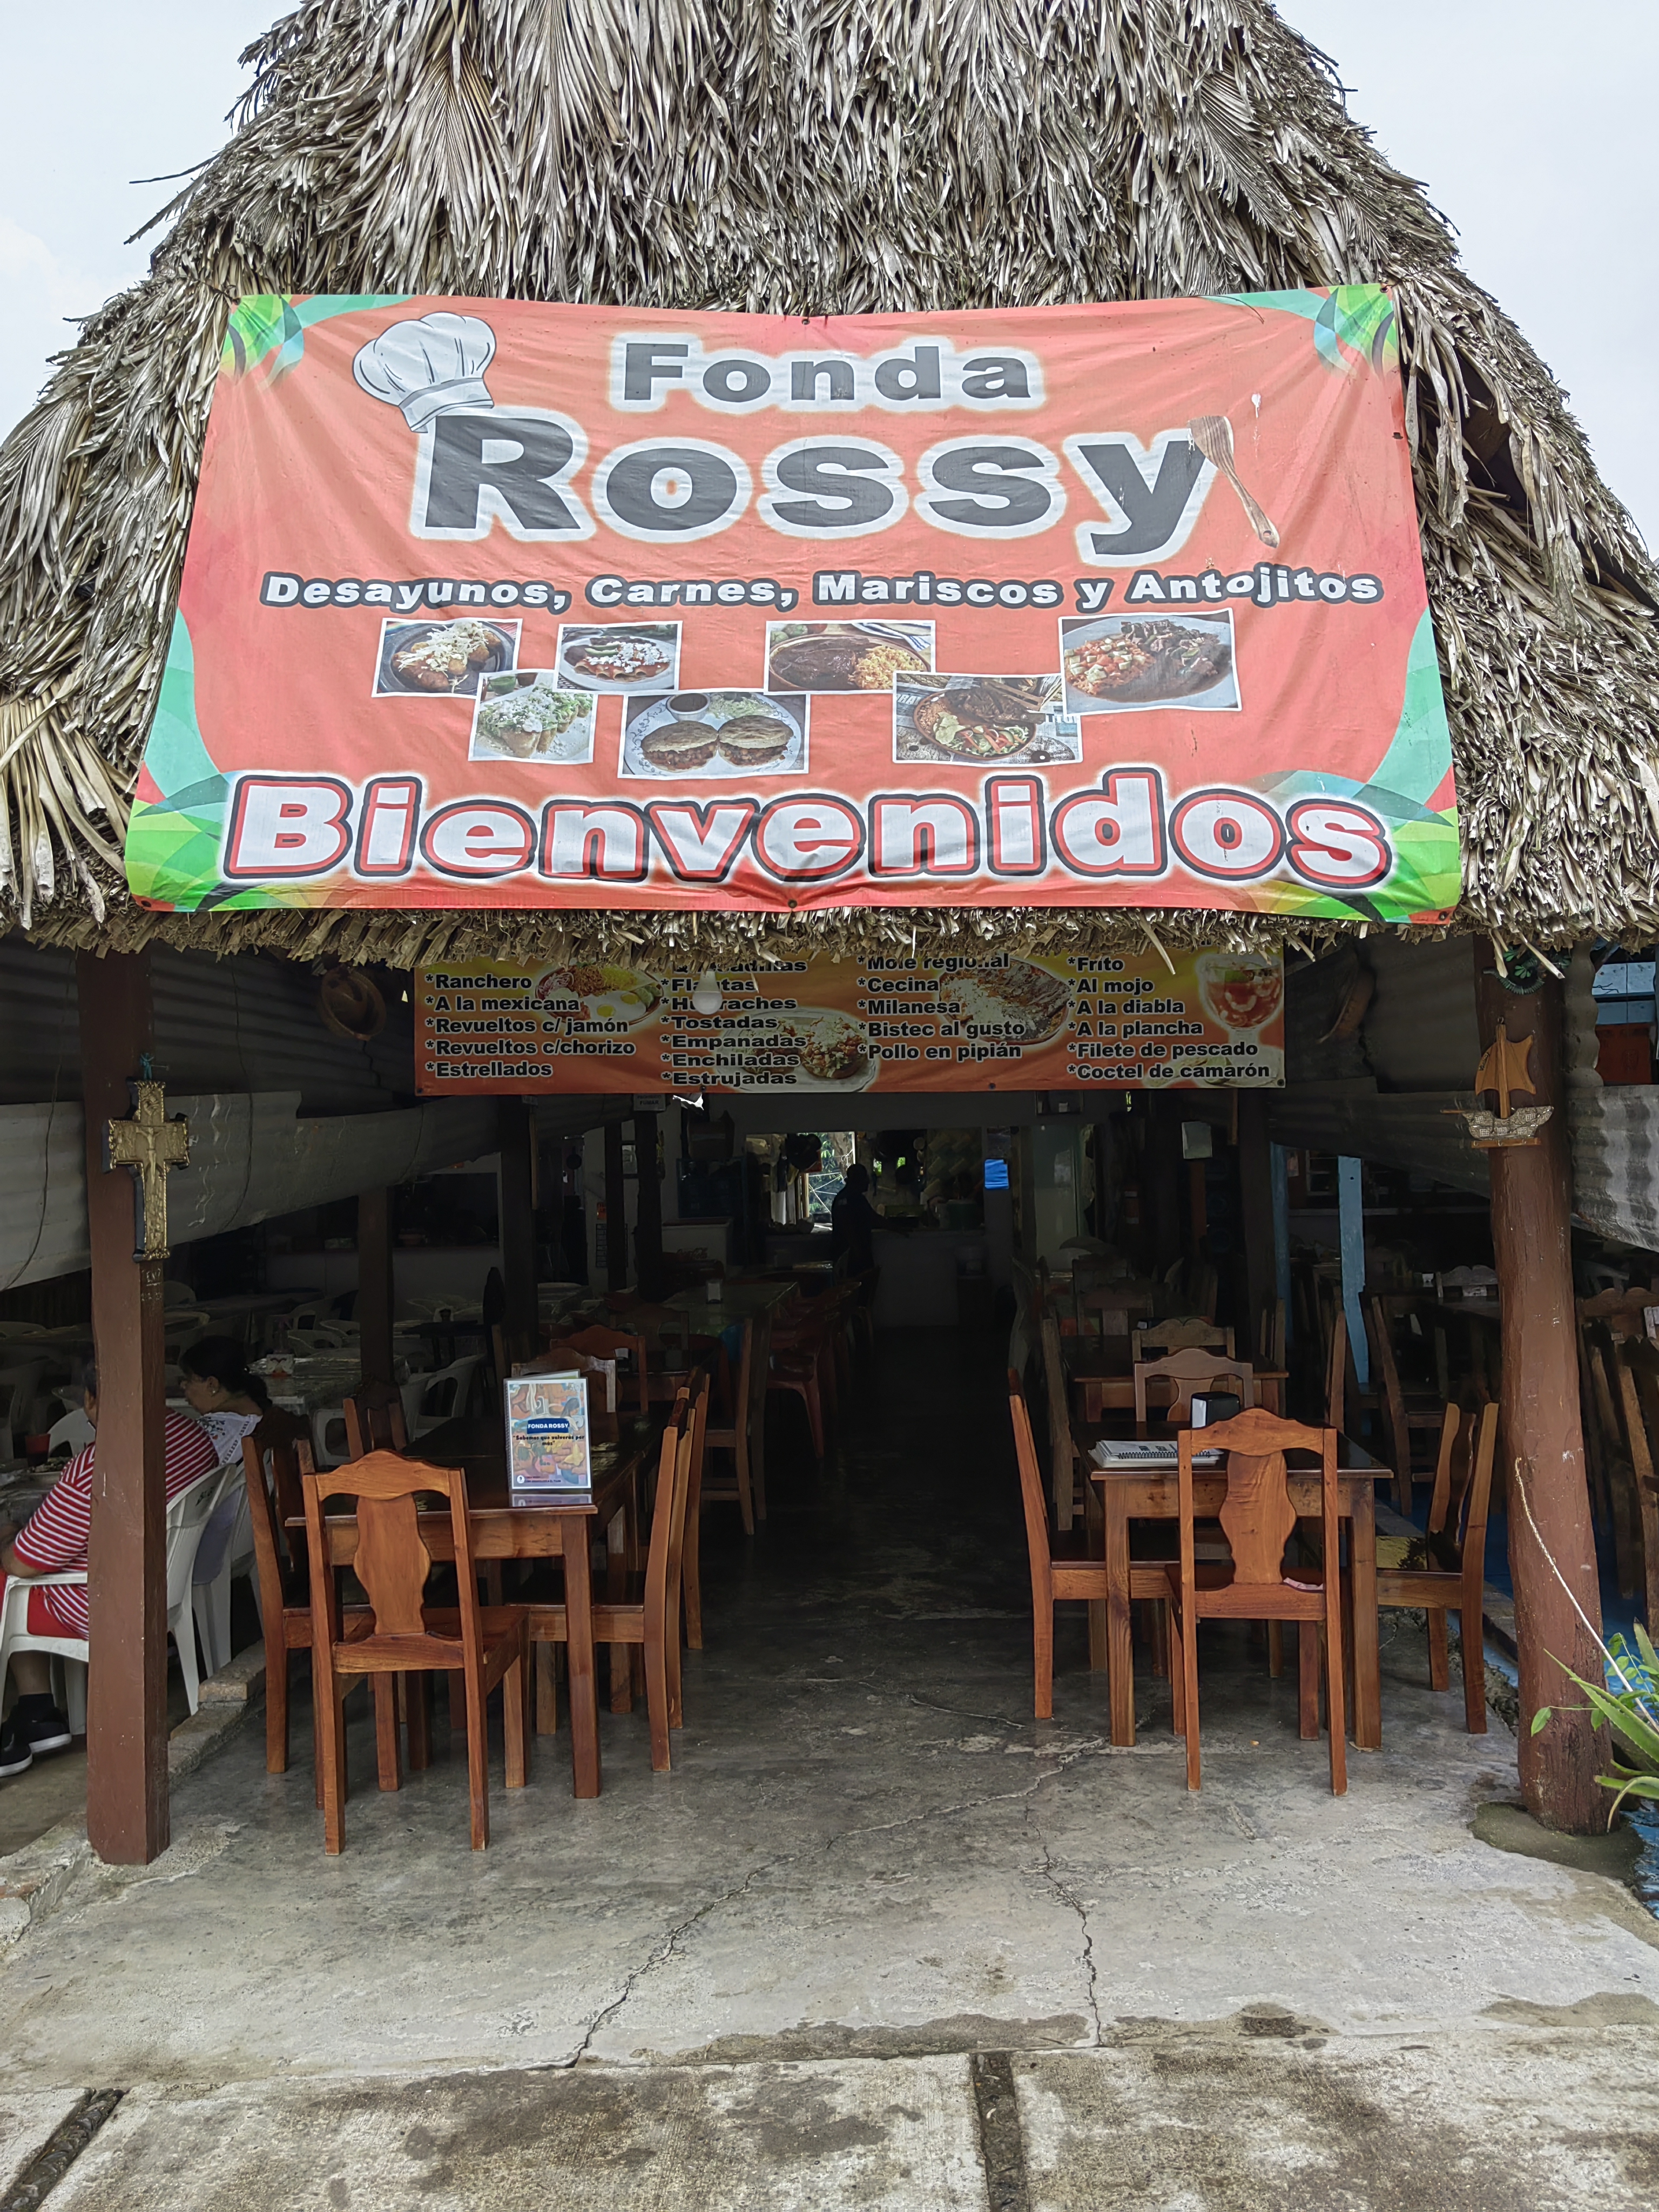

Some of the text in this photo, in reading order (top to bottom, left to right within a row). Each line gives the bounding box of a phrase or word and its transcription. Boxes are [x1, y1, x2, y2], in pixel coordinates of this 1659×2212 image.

[622, 340, 1033, 404] Fonda
[423, 413, 1210, 557] Rossy
[264, 565, 1380, 611] Desayunos, Carnes, Mariscos y Antojitos
[227, 771, 1390, 886] Bienvenidos
[1104, 979, 1154, 996] mojo
[456, 996, 473, 1011] la
[481, 996, 580, 1011] mexicana
[1098, 1000, 1117, 1014] la
[1123, 999, 1184, 1014] diabla
[542, 1019, 559, 1033] c/
[565, 1019, 628, 1036] jamón
[941, 1022, 960, 1036] al
[966, 1022, 1025, 1040] gusto
[1097, 1021, 1117, 1036] la
[1122, 1021, 1203, 1038] plancha
[543, 1040, 636, 1055] c/chorizo
[925, 1047, 952, 1058] en
[957, 1043, 1022, 1062] pipián
[1140, 1043, 1166, 1057] de
[1171, 1042, 1258, 1060] pescado
[1149, 1064, 1175, 1078] de
[1180, 1062, 1270, 1078] camarón
